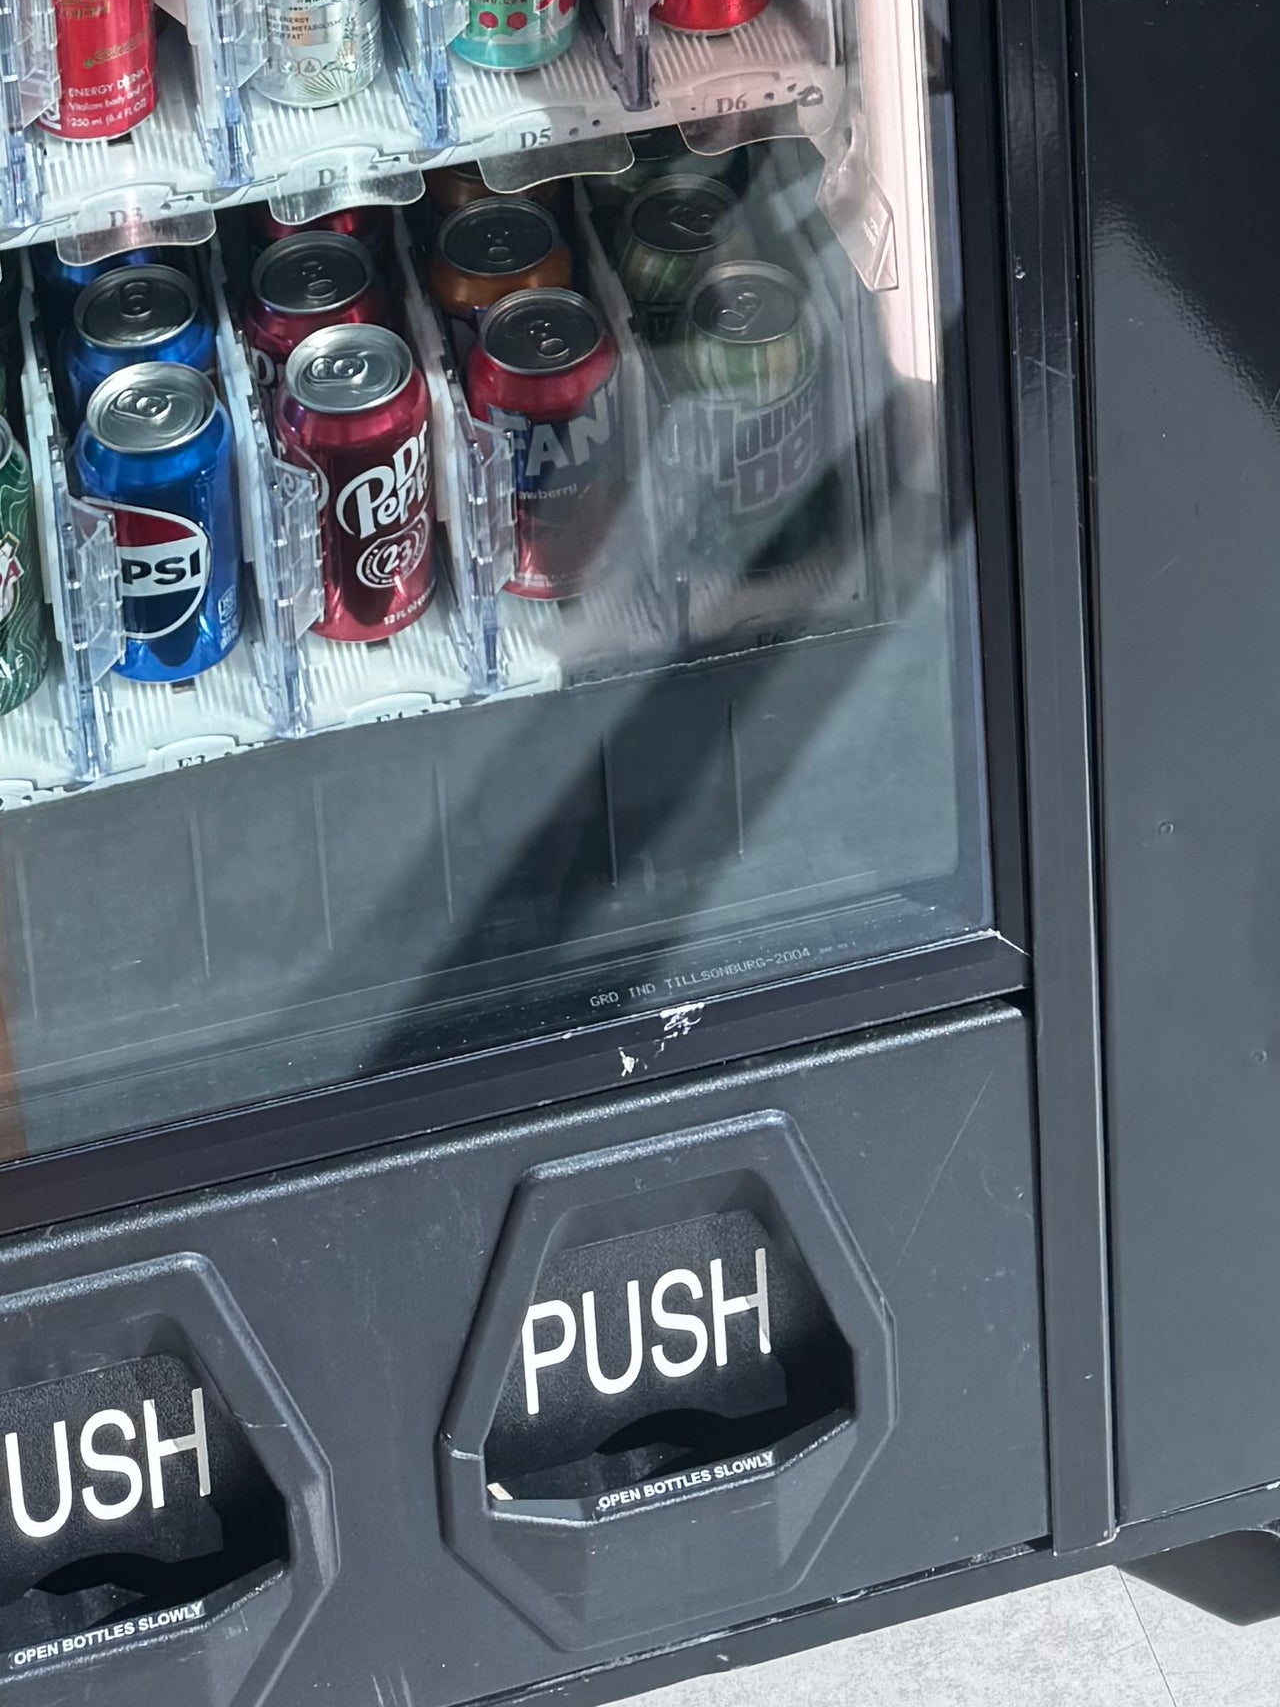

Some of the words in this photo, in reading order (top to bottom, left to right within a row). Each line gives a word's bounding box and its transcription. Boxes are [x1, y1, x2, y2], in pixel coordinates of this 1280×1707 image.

[68, 82, 114, 98] ENERGY
[715, 93, 747, 115] D6
[519, 127, 552, 149] D5
[109, 206, 144, 230] D3
[121, 547, 201, 585] PSI
[382, 539, 414, 574] 23
[383, 614, 396, 627] 12
[396, 609, 407, 621] FL
[590, 991, 619, 1007] GRD
[628, 983, 656, 999] IND
[519, 1247, 773, 1416] PUSH
[598, 1488, 641, 1510] OPEN
[643, 1469, 711, 1498] BOTTLES
[714, 1450, 773, 1479] SLOWLY
[14, 1642, 58, 1665] OPEN
[62, 1621, 135, 1652] BOTTLES
[138, 1600, 203, 1632] SLOWLY
